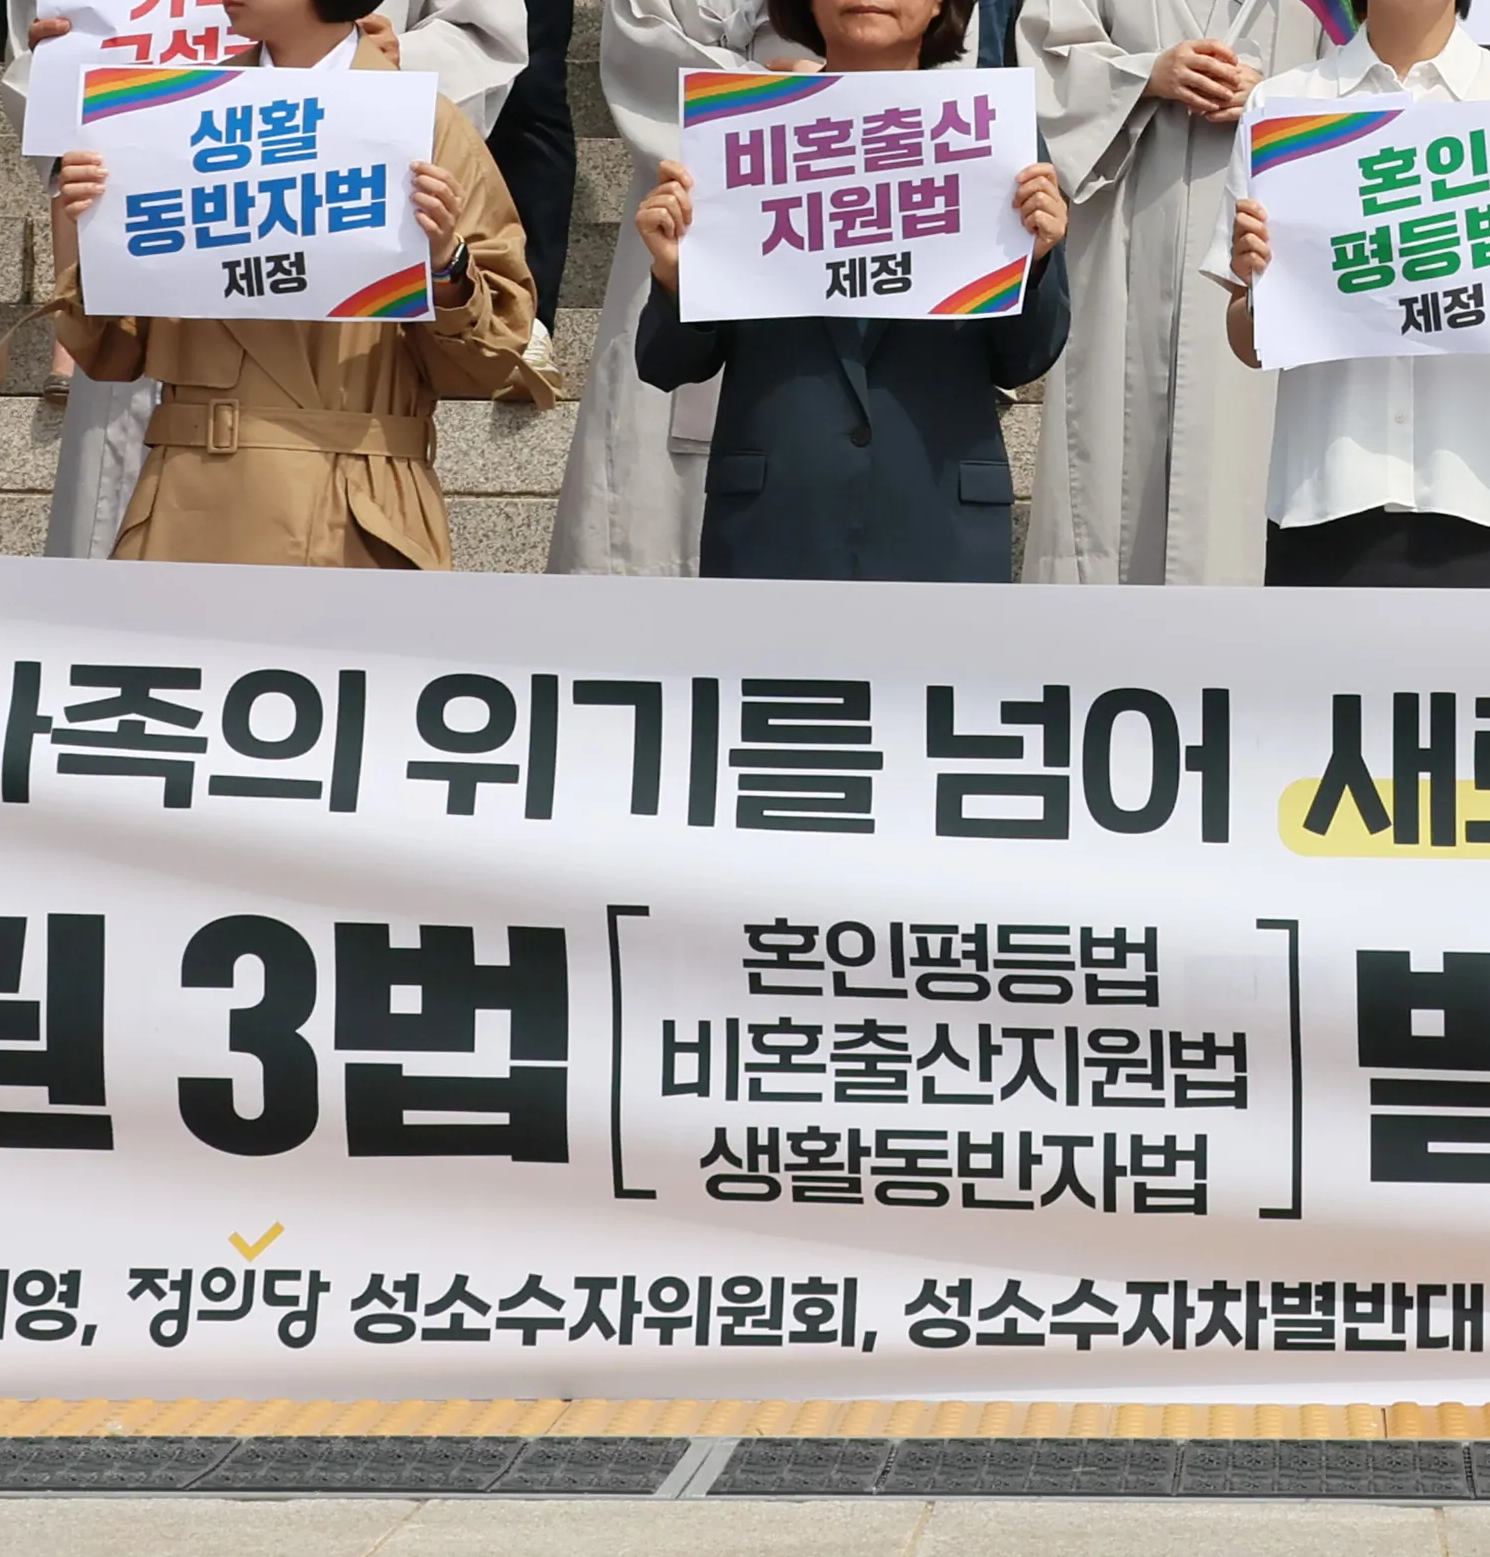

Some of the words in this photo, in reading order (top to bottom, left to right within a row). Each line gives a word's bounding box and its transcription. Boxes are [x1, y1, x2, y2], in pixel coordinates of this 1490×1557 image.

[184, 90, 330, 179] 생활
[724, 93, 995, 188] 비혼출산
[124, 163, 387, 257] 동반자법
[759, 173, 962, 257] 지원법
[223, 252, 307, 297] 제정
[820, 246, 911, 298] 제정
[1392, 277, 1485, 333] 제정
[407, 674, 883, 833] 위기를
[927, 685, 1229, 842] 넘어
[743, 918, 1159, 1007] 혼인평등법
[178, 915, 569, 1163] 3법
[662, 1017, 1247, 1109] 비혼출산지원법
[701, 1126, 1207, 1215] 생활동반자법
[129, 1268, 330, 1348] 정의당
[351, 1274, 876, 1352] 성소수자위원회,
[906, 1279, 1483, 1352] 성소수자차별반대
